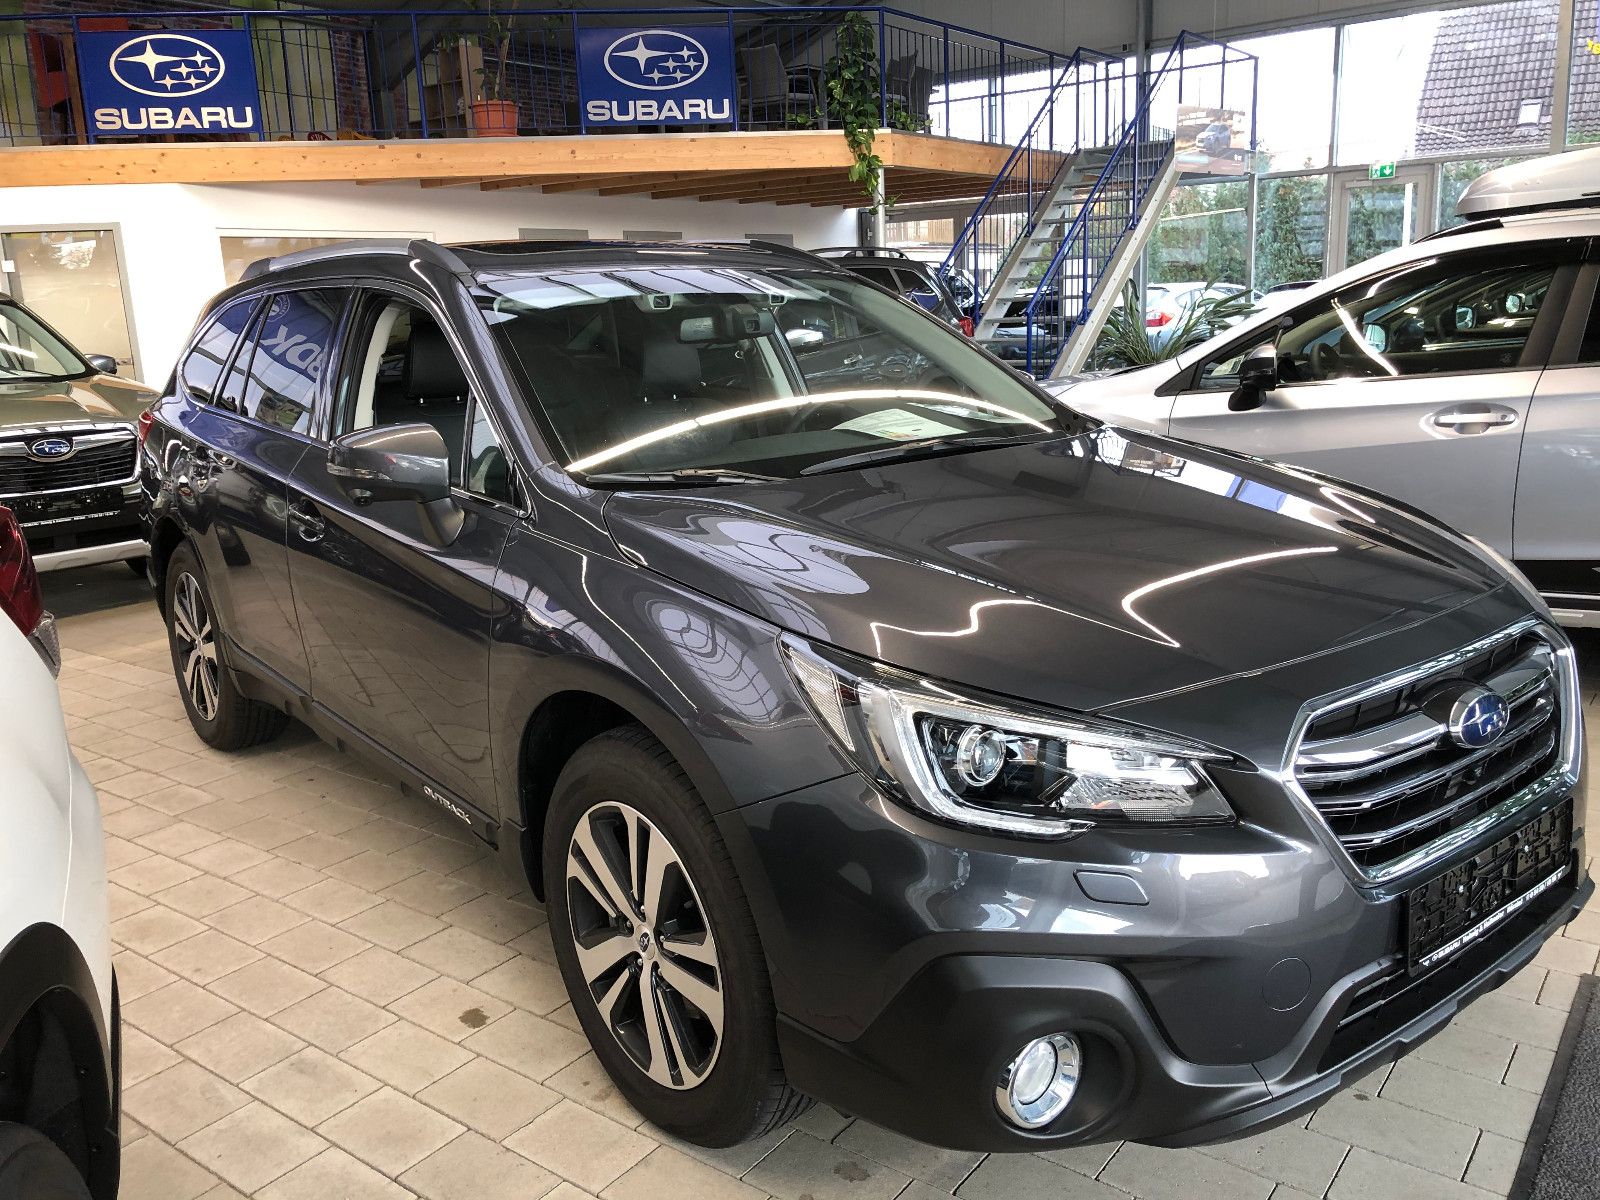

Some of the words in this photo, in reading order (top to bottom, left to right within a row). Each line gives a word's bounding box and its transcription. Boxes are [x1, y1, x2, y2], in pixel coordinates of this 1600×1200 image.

[94, 106, 253, 130] SUBARU
[586, 98, 730, 121] SUBARU
[423, 785, 471, 825] OUTBACK
